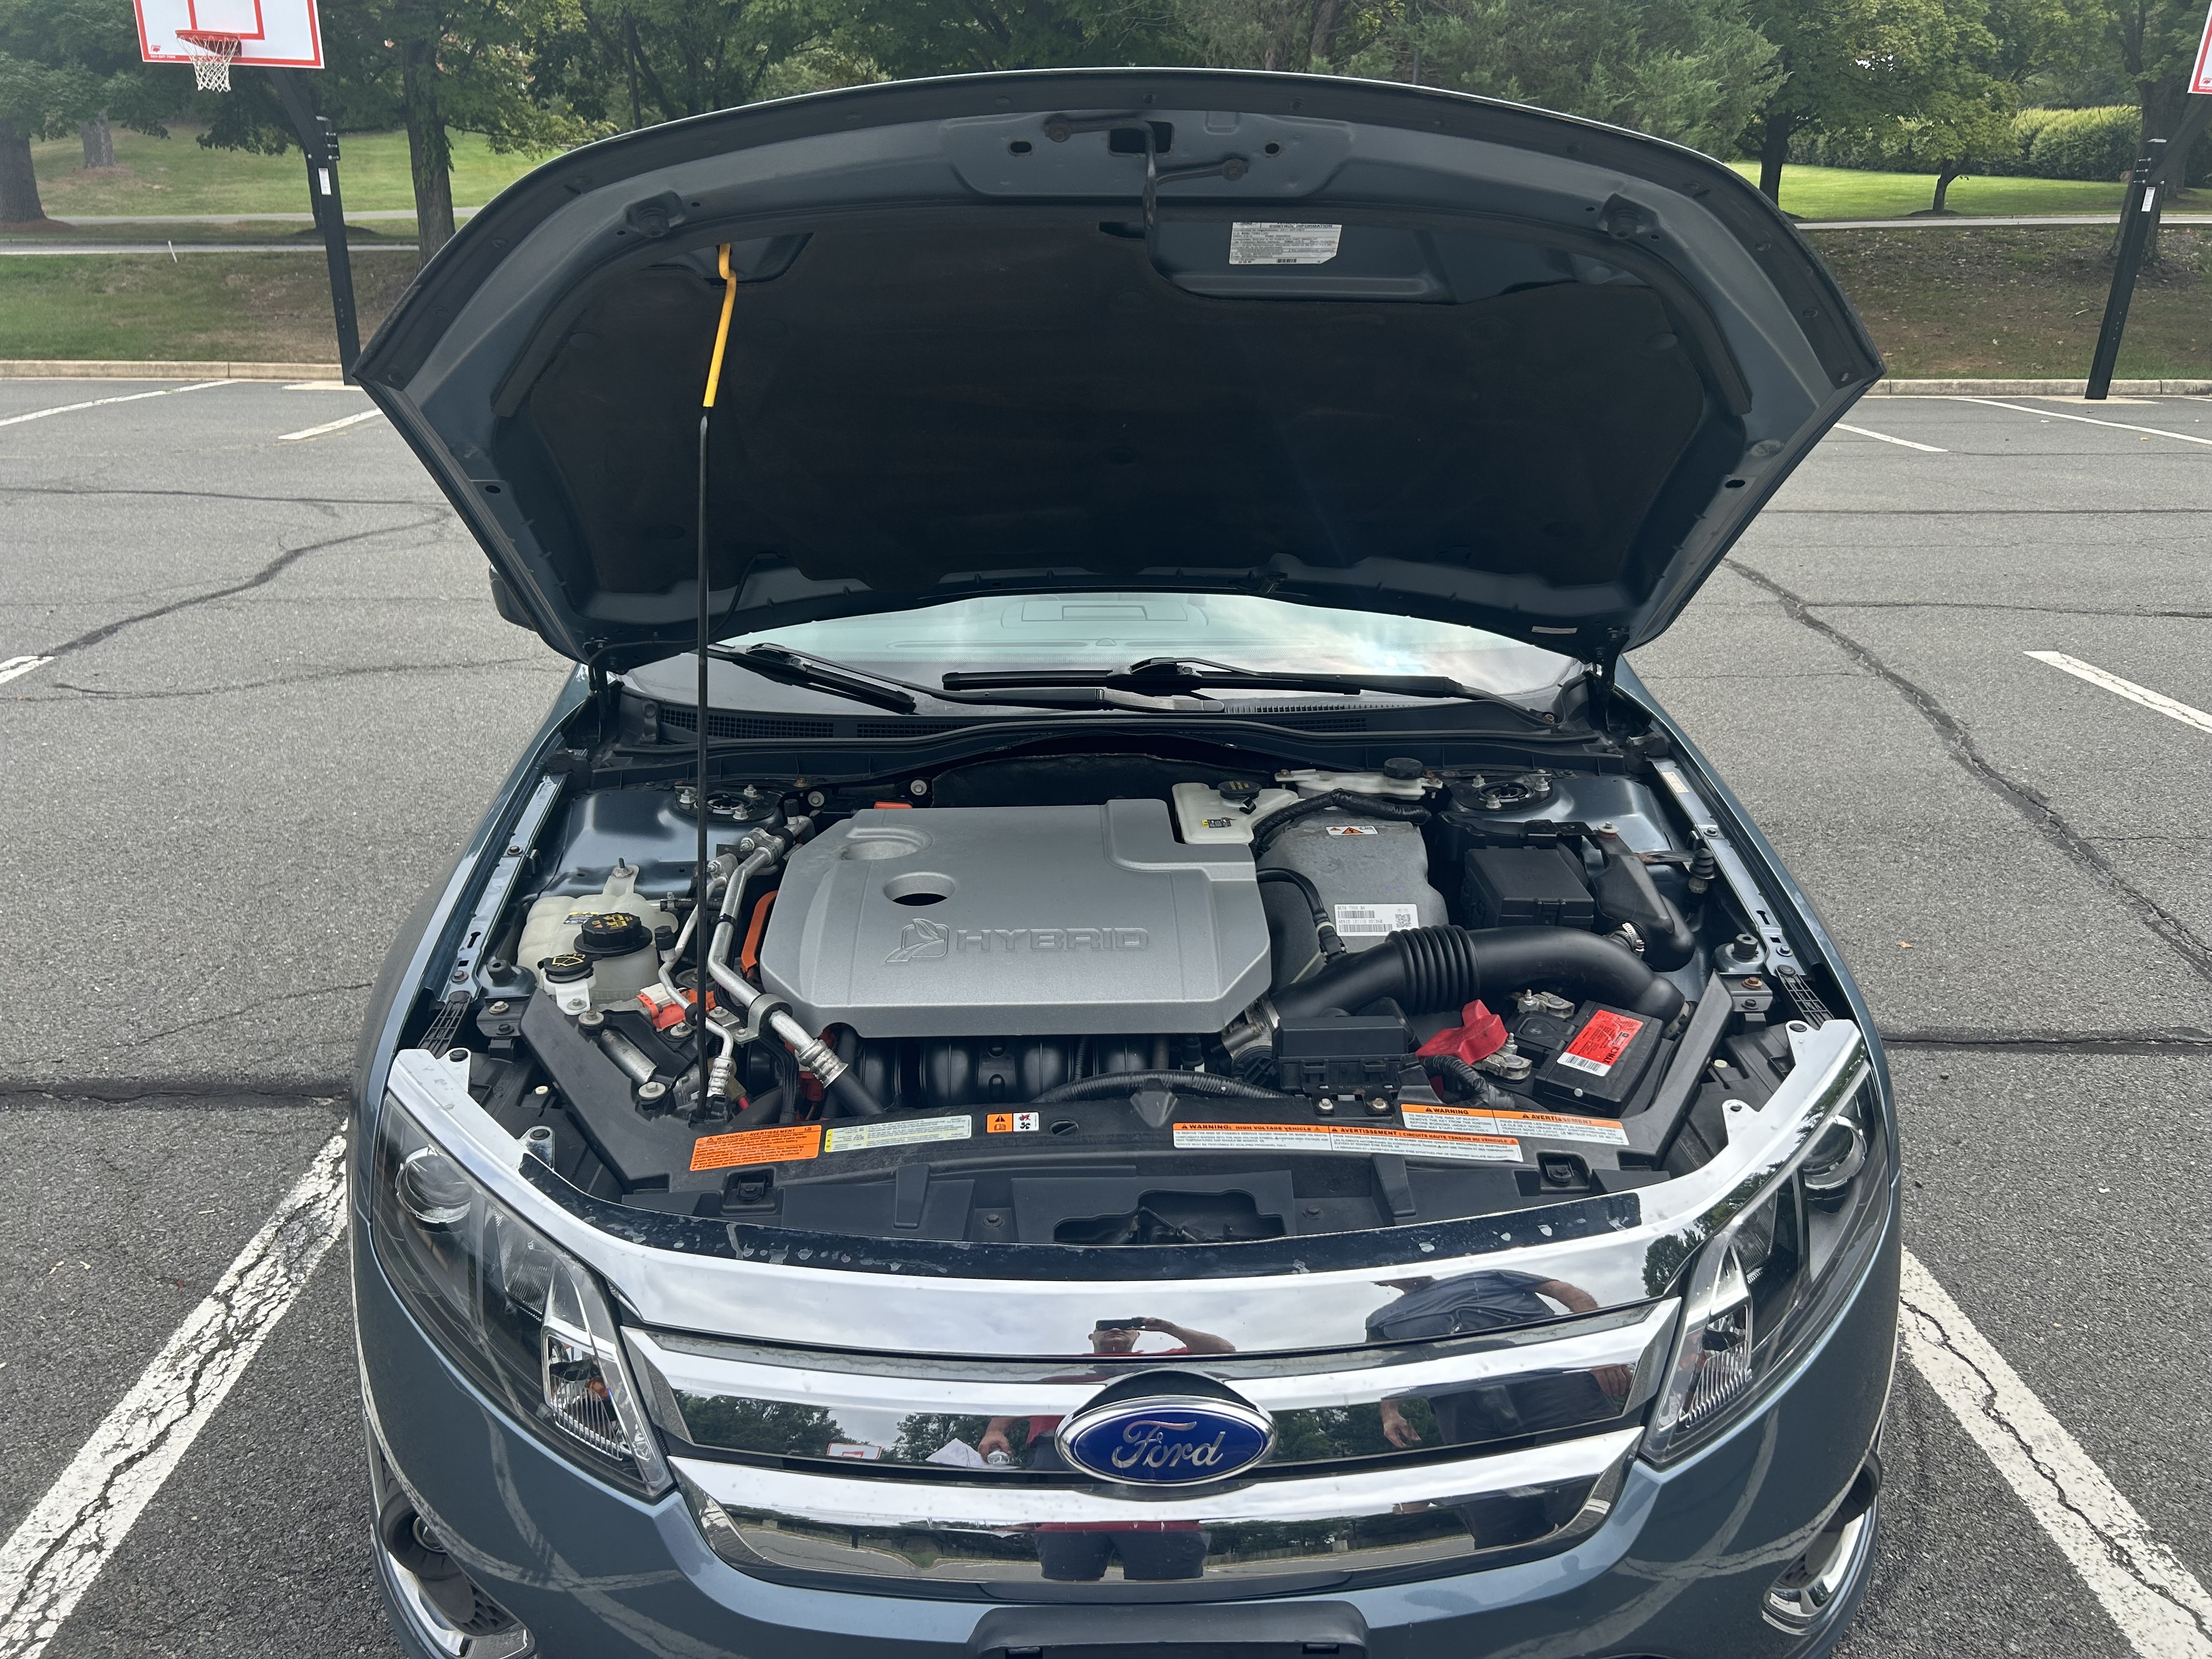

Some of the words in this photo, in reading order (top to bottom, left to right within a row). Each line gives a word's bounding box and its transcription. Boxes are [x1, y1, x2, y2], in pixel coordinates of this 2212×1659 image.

[957, 928, 1149, 952] HYBRID
[1531, 1114, 1593, 1125] AVERTISSEMENT
[1111, 1420, 1226, 1469] Ford
